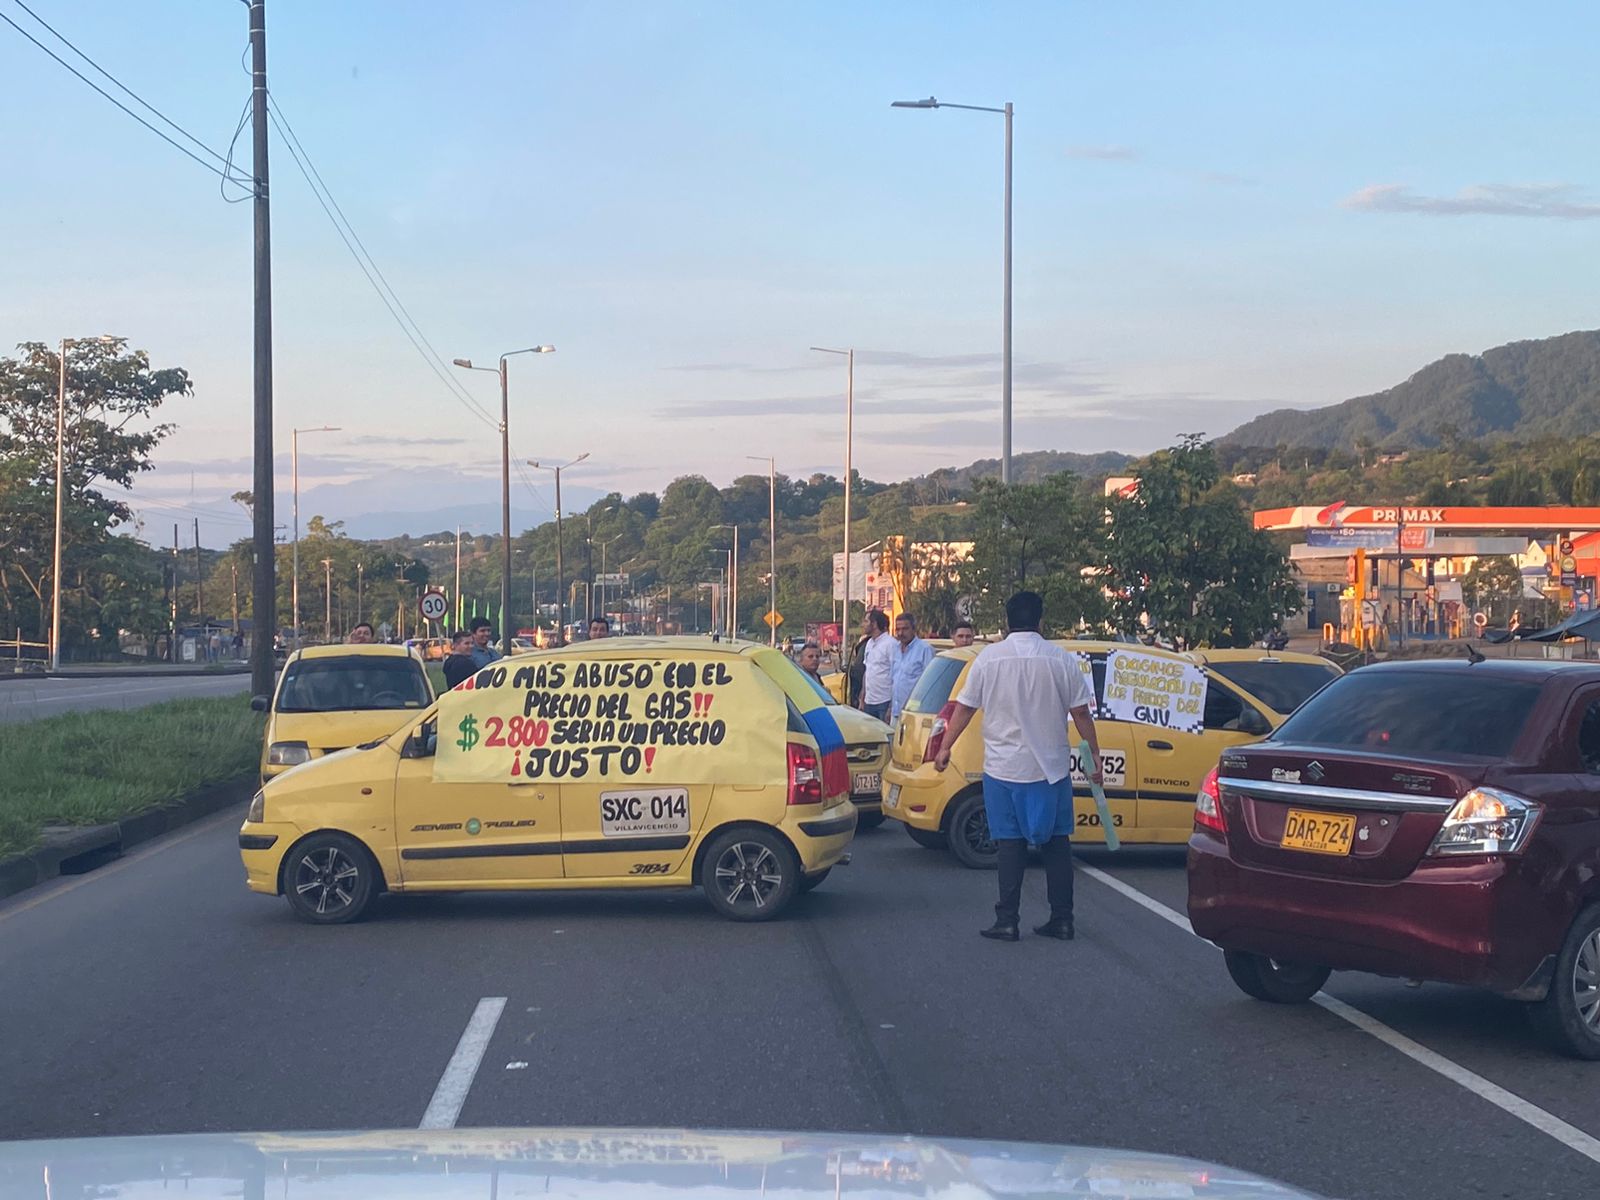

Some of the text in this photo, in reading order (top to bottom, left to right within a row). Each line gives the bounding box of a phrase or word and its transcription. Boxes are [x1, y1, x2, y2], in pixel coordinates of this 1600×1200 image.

[1372, 510, 1443, 521] PRIMAX
[425, 598, 443, 614] 30
[664, 662, 696, 689] EN
[702, 662, 733, 686] EL
[1189, 680, 1203, 697] DE
[524, 690, 591, 719] PRECIO
[596, 692, 632, 720] DEL
[1176, 697, 1200, 714] DEL
[551, 720, 615, 744] SERIA
[618, 722, 649, 745] UN
[649, 720, 726, 746] PRECIO
[510, 745, 656, 778] ¡JUSTO!
[1143, 777, 1190, 787] SERVICIO
[602, 795, 687, 821] SXC 014
[614, 823, 678, 832] VILLAVICENCIO
[1076, 813, 1123, 827] 203
